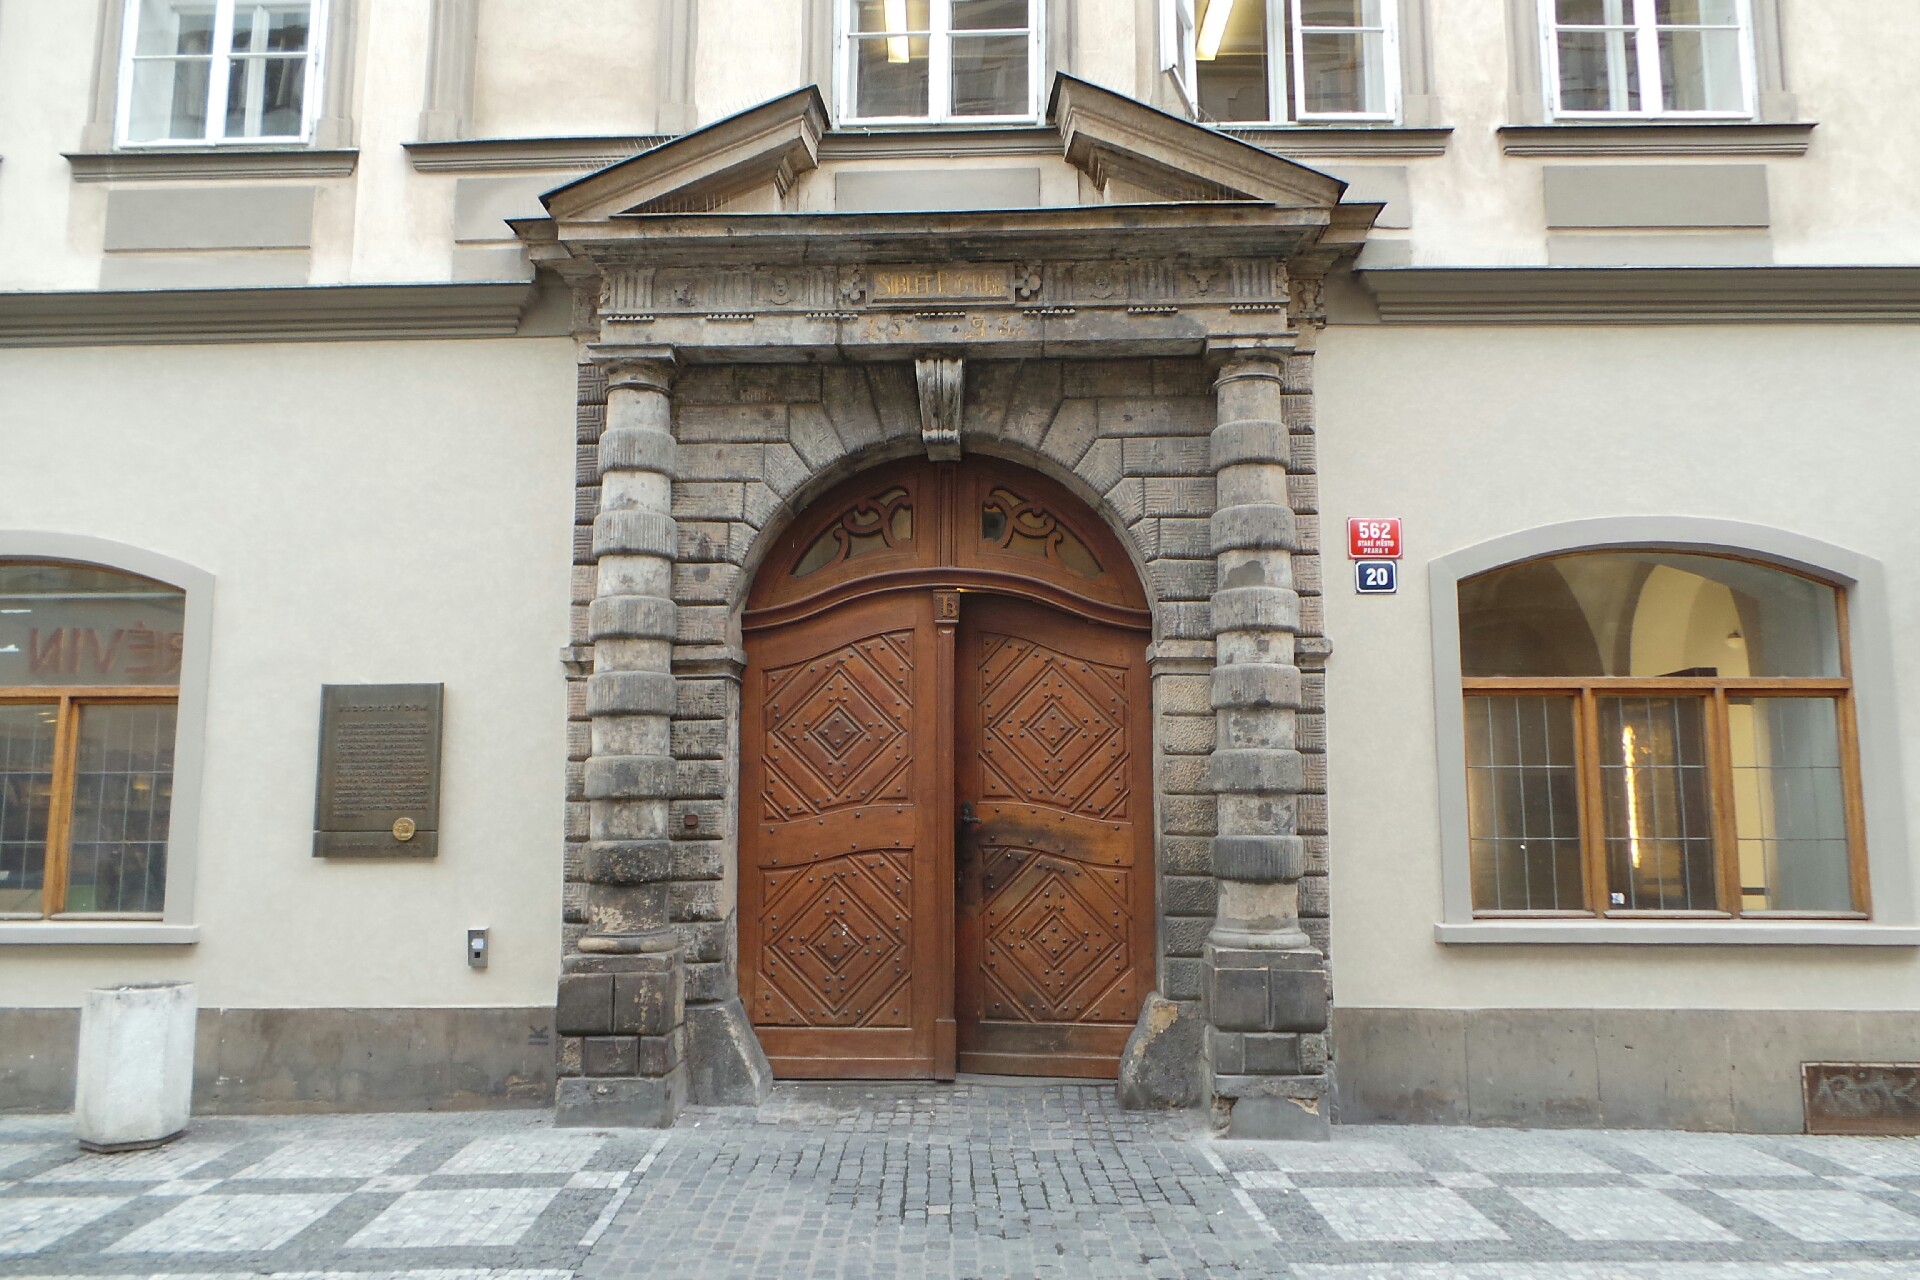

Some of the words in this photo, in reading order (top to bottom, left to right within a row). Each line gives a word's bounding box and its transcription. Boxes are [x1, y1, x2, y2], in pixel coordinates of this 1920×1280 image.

[1358, 521, 1391, 539] 562
[1358, 538, 1374, 547] STARÉ
[1376, 538, 1394, 547] MĚSTO
[1366, 567, 1388, 586] 20
